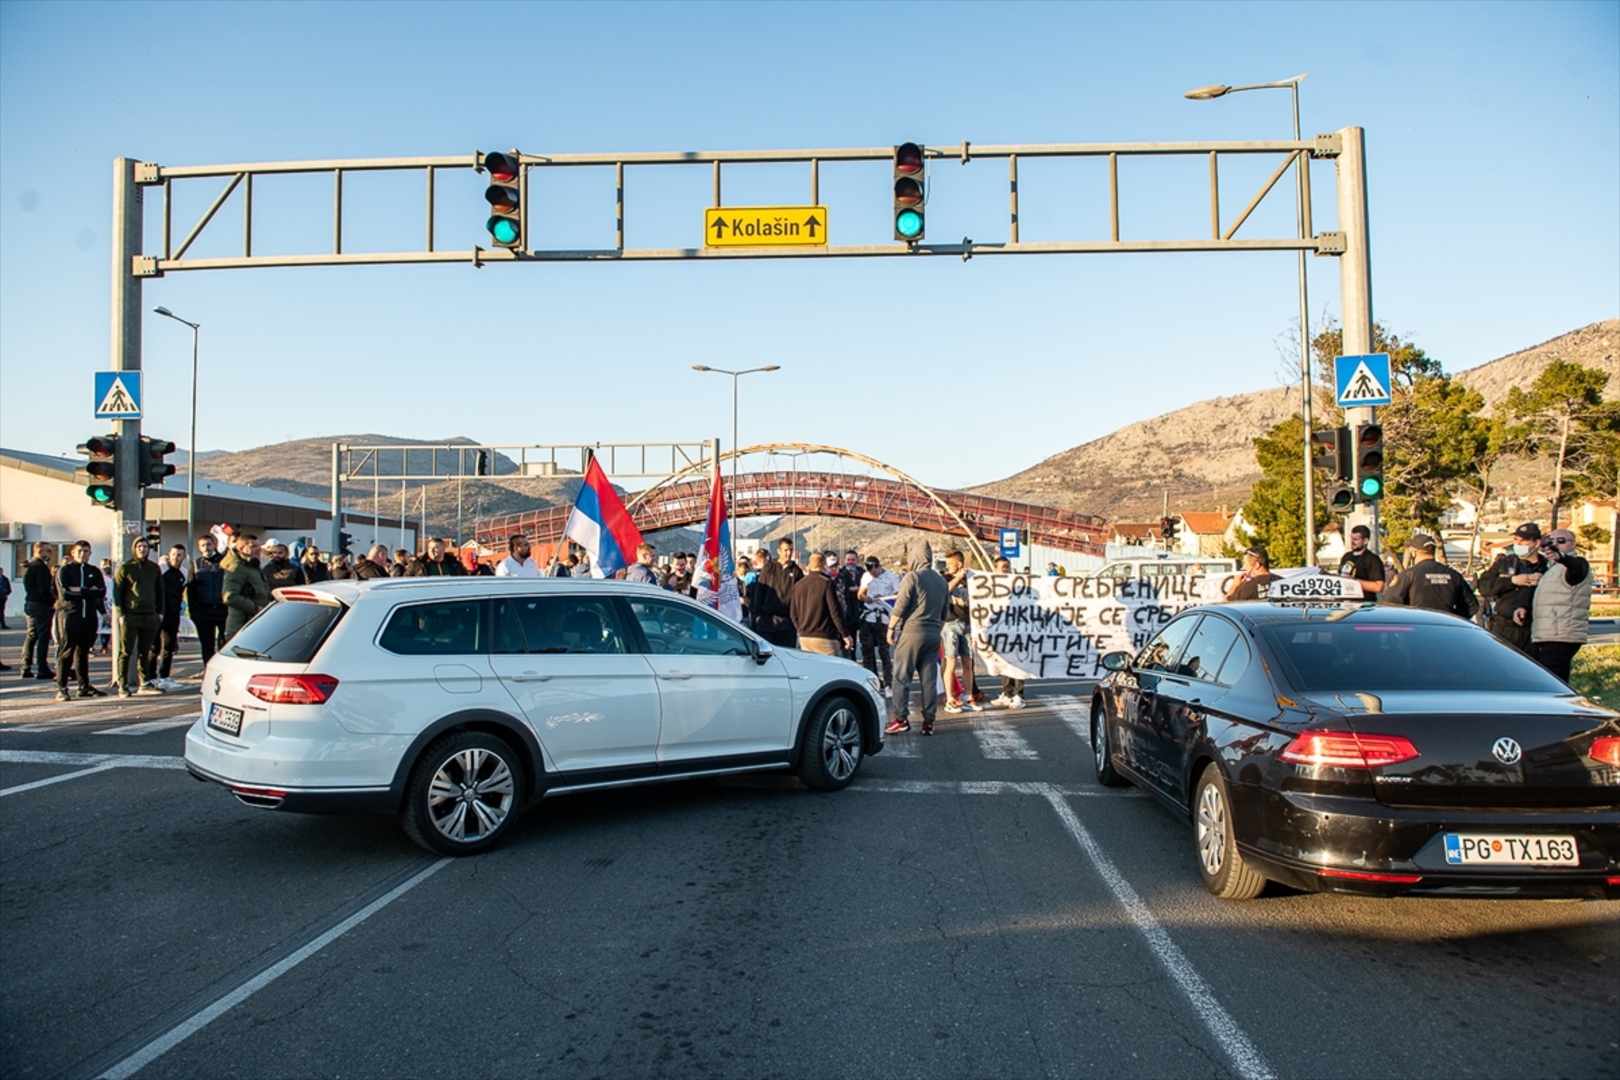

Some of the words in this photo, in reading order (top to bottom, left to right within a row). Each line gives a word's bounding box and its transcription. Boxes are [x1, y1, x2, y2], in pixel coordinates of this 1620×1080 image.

[732, 217, 800, 237] Kolašin
[972, 574, 1041, 600] ЗБОГ
[1053, 575, 1206, 602] СРЕБРЕНИЦЕ
[1280, 584, 1302, 596] PG
[1301, 588, 1342, 596] TAXI
[1300, 578, 1342, 589] 19704
[971, 602, 1087, 629] ФУНКЦИЈЕ
[1099, 606, 1126, 627] СЕ
[976, 633, 1112, 654] УПАМТИТЕ
[1462, 838, 1491, 860] PG
[1504, 839, 1574, 861] TX163
